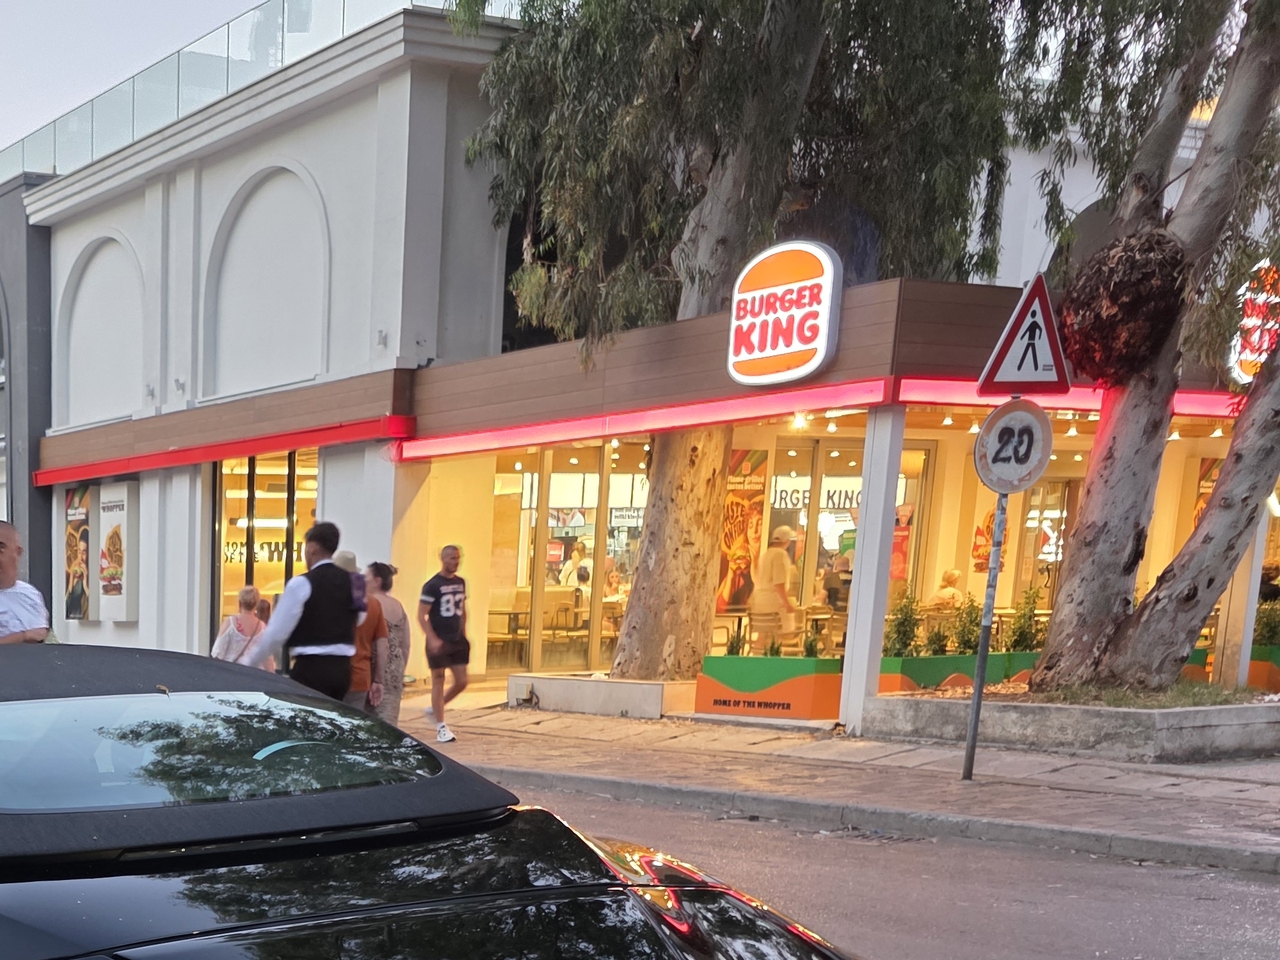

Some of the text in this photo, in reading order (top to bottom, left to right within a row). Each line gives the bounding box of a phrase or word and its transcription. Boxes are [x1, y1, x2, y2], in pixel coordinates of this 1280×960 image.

[735, 283, 823, 321] BURGER
[733, 310, 820, 357] KING
[991, 425, 1034, 465] 20
[712, 699, 791, 710] HOME OF THE WHOPPER
